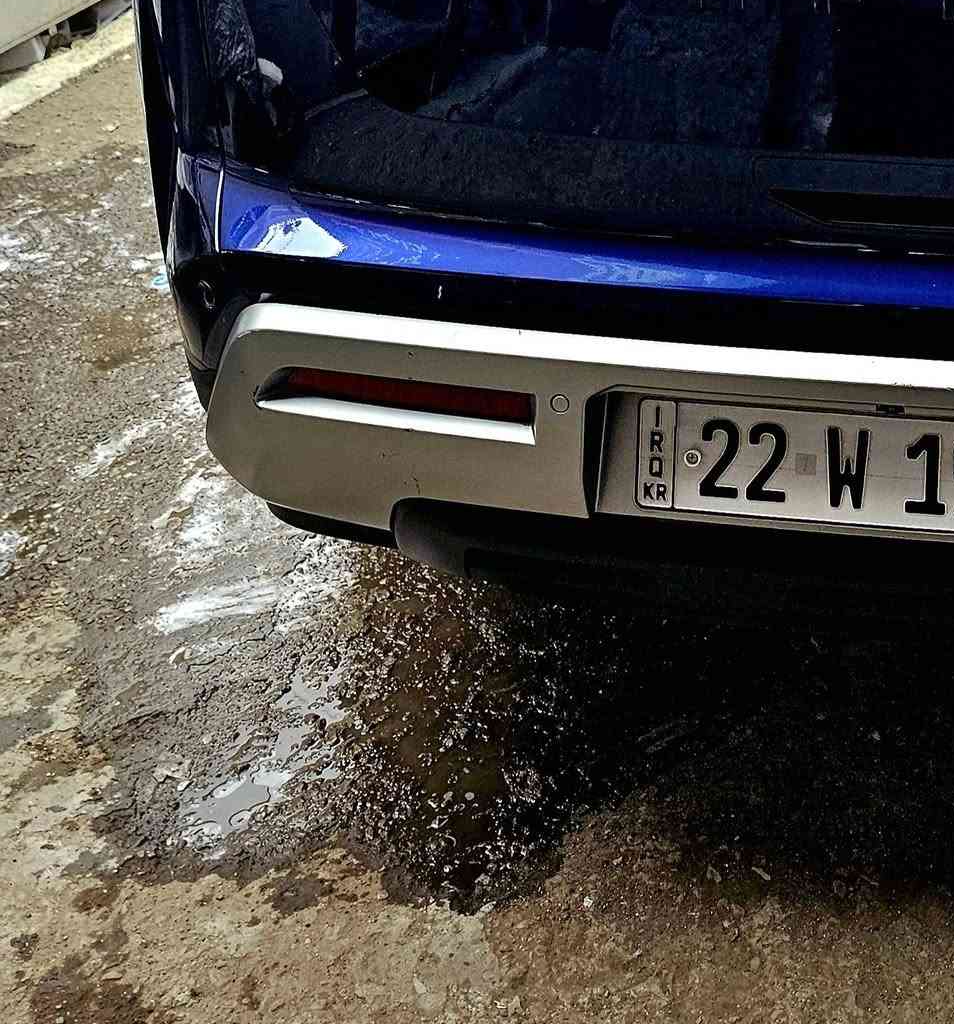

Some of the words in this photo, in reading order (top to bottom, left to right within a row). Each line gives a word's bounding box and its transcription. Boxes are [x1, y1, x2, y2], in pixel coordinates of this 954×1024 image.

[643, 481, 667, 501] KR
[699, 417, 788, 503] 22
[824, 426, 871, 510] W
